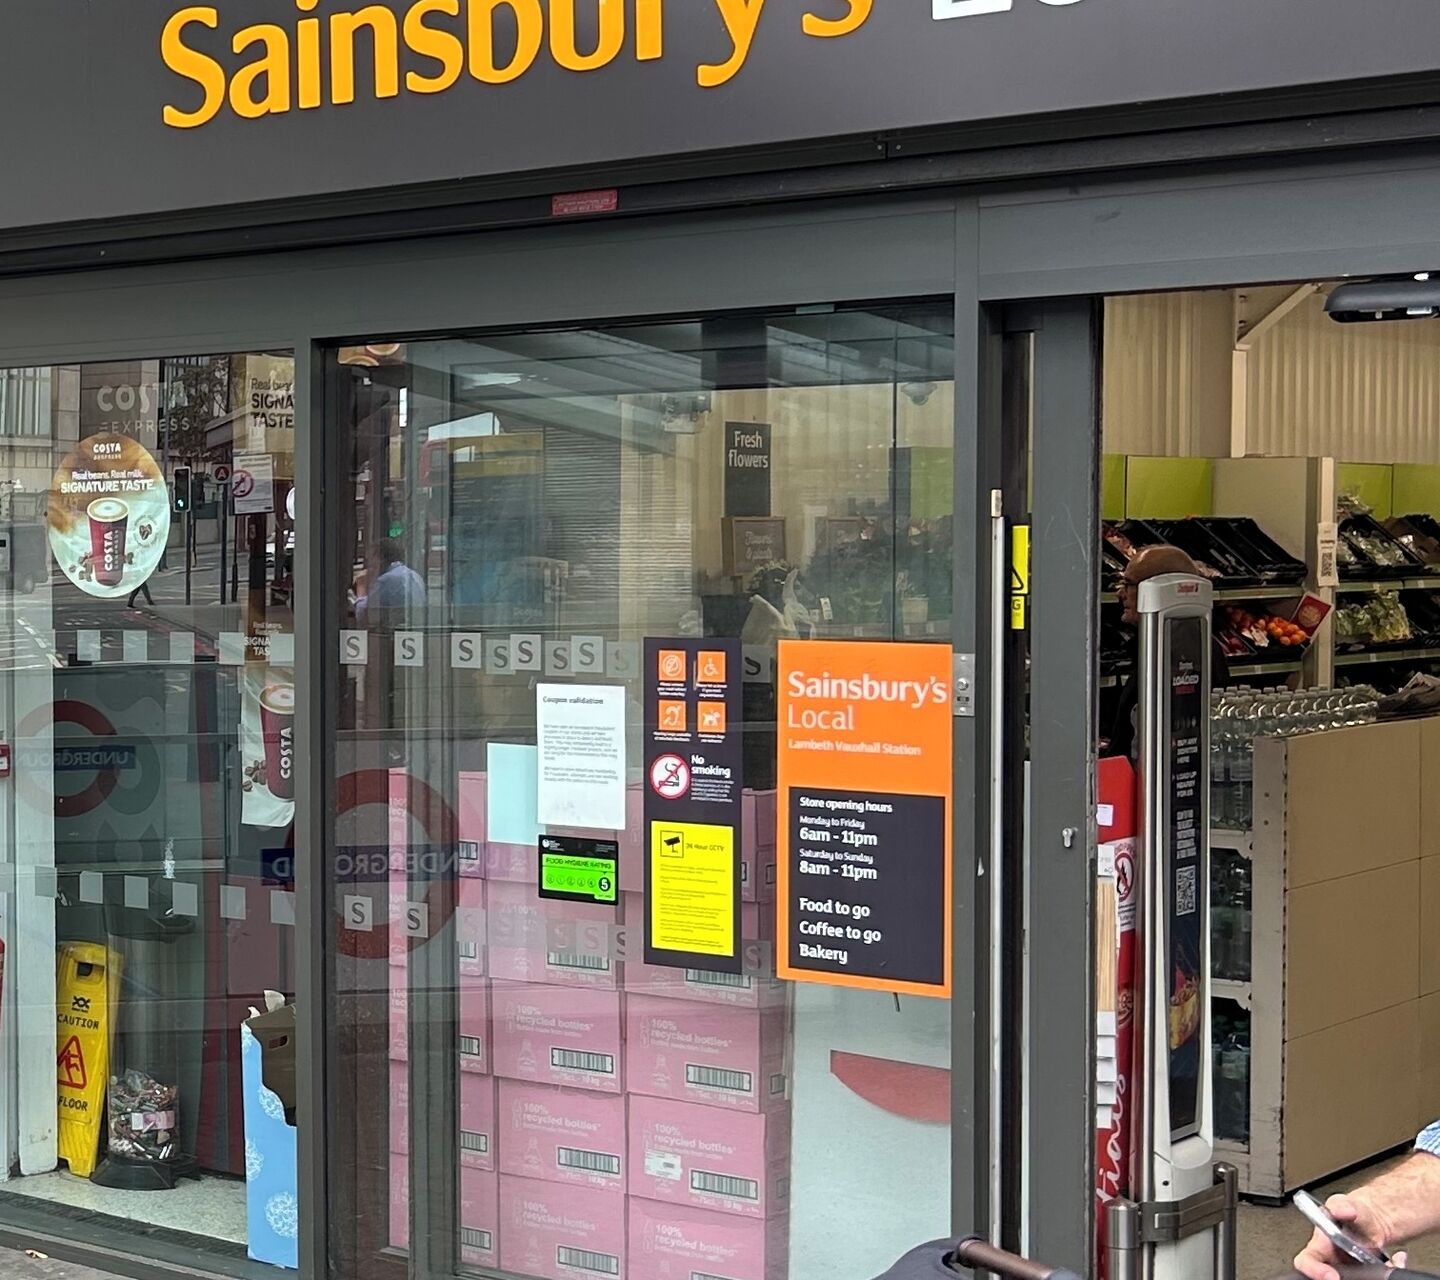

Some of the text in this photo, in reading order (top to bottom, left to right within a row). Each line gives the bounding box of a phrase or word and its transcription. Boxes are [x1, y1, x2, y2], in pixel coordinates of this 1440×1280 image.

[251, 393, 294, 409] SIGNA
[111, 418, 190, 434] EXPRESS
[734, 431, 762, 448] Fresh
[93, 443, 121, 453] COSTA
[728, 449, 768, 468] flowers
[71, 470, 87, 480] Real
[111, 469, 126, 479] Real
[60, 481, 119, 493] SIGNATURE
[104, 531, 113, 571] COSTA
[244, 636, 271, 646] SIGNA
[346, 636, 360, 658] S
[402, 637, 416, 660] S
[459, 639, 473, 662] S
[518, 640, 533, 663] S
[579, 642, 595, 666] S
[788, 671, 947, 709] Sainsbury's
[788, 704, 854, 730] Local
[280, 727, 293, 779] COSTA
[788, 739, 922, 756] Lambeth Vauxhall Station
[691, 754, 705, 765] No
[691, 765, 731, 779] smoking
[799, 796, 893, 814] Store opening hours
[799, 815, 865, 830] Monday to Friday
[799, 827, 830, 842] 6am
[841, 830, 878, 847] 11pm
[799, 848, 873, 864] Saturday to Sunday
[799, 860, 830, 876] 8am
[841, 864, 878, 881] 11pm
[601, 878, 608, 890] 5
[799, 897, 870, 919] Food to go
[351, 902, 365, 924] S
[407, 908, 421, 931] S
[799, 921, 881, 944] Coffee to go
[799, 943, 848, 964] Bakery
[57, 1013, 99, 1030] CAUTION
[652, 1019, 677, 1031] 100%
[650, 1029, 693, 1041] recycled
[58, 1095, 88, 1111] FLOOR
[523, 1103, 548, 1114] 100%
[523, 1112, 562, 1125] recycled
[654, 1123, 681, 1136] 100%
[654, 1134, 696, 1148] recycled
[523, 1201, 548, 1214] 100%
[522, 1211, 561, 1224] recycled
[656, 1224, 682, 1237] 100%
[655, 1235, 697, 1251] recycled
